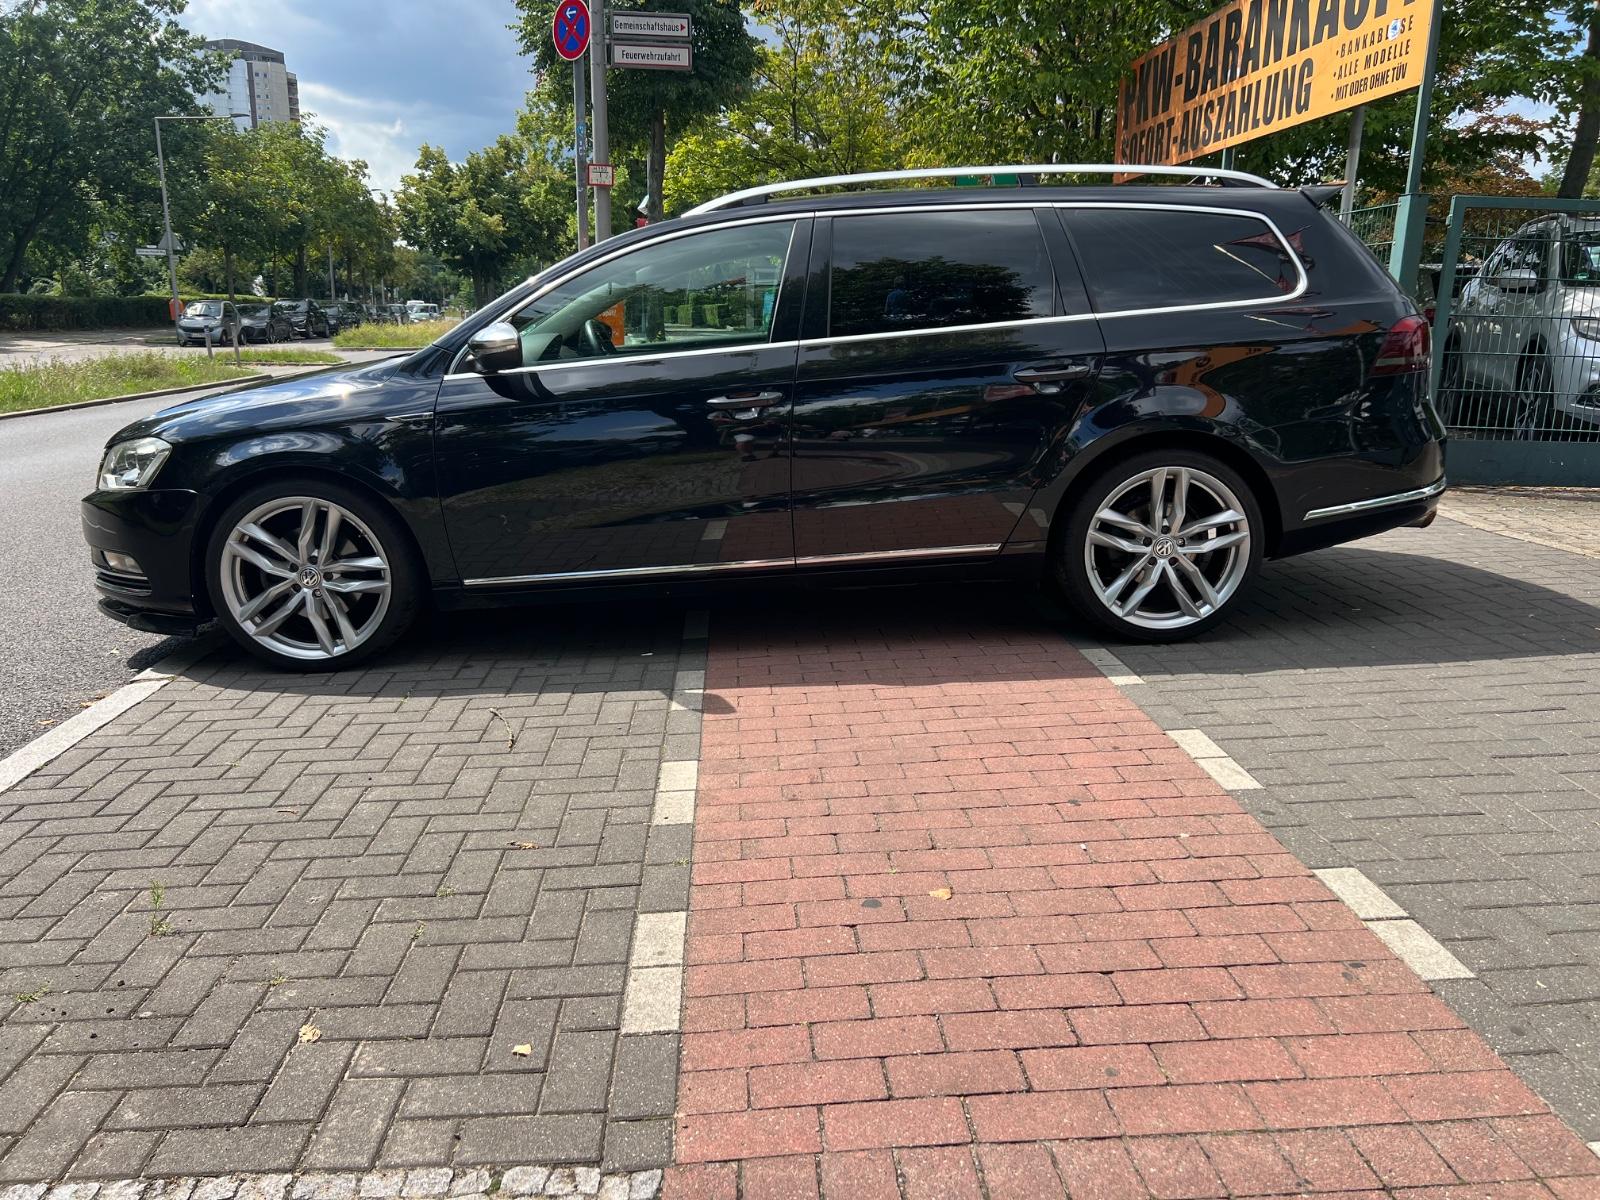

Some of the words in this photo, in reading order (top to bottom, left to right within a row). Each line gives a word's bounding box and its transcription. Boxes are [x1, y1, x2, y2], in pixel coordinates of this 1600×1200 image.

[614, 19, 679, 32] Gemeinschaftshaus
[1341, 14, 1414, 58] BANKABLSE
[621, 49, 681, 61] Feuerwehrzufahrt
[1338, 59, 1359, 80] ALLE
[1364, 39, 1411, 70] MODELLE
[1335, 84, 1349, 101] MIT
[1350, 78, 1369, 97] ODER
[1370, 69, 1391, 90] OHNE
[1391, 61, 1408, 81] TÜV
[1122, 58, 1314, 165] SOFORT-AUSZAHLUNG
